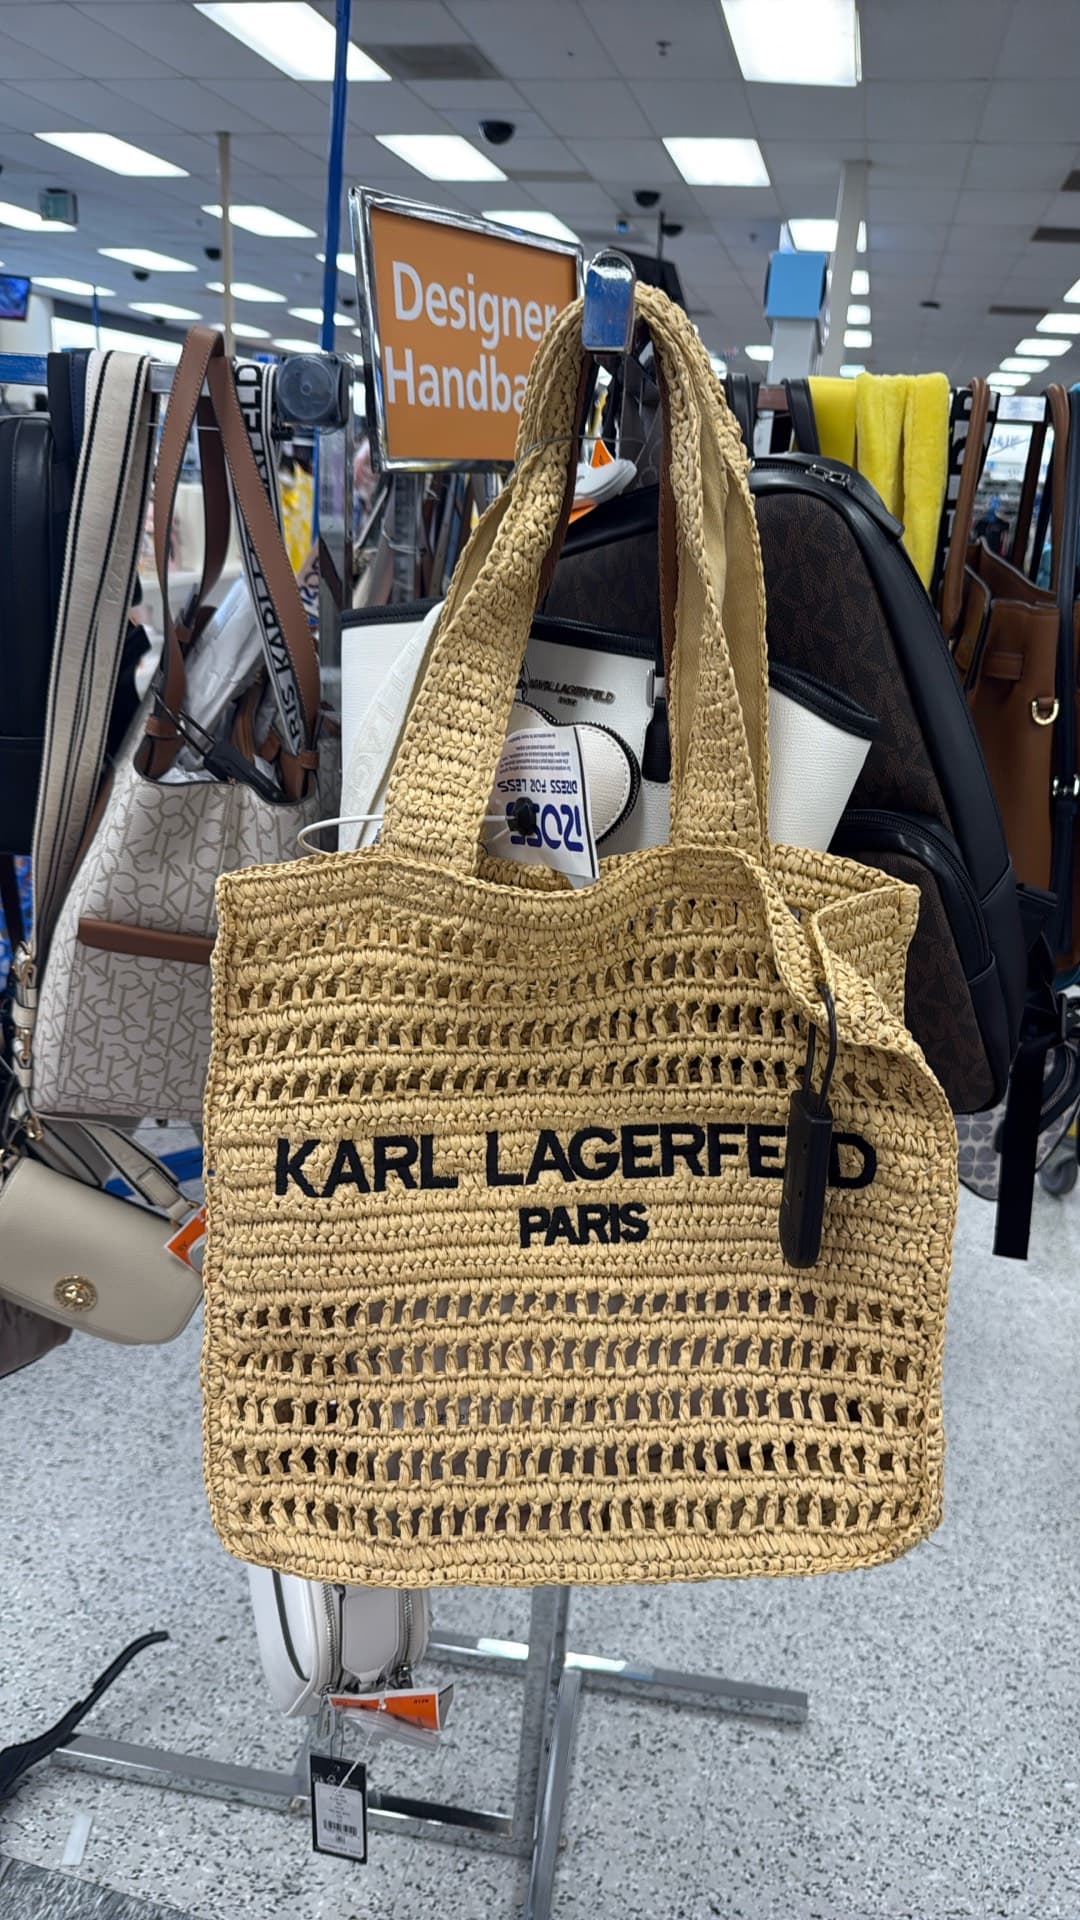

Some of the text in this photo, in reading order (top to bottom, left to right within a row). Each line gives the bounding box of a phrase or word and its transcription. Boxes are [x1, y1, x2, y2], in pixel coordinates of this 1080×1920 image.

[392, 261, 556, 349] Designer
[384, 346, 527, 415] Handba
[497, 779, 578, 794] DRESS FOR LESS
[275, 1122, 877, 1198] KARL LAGERFED
[519, 1202, 650, 1248] PARIS
